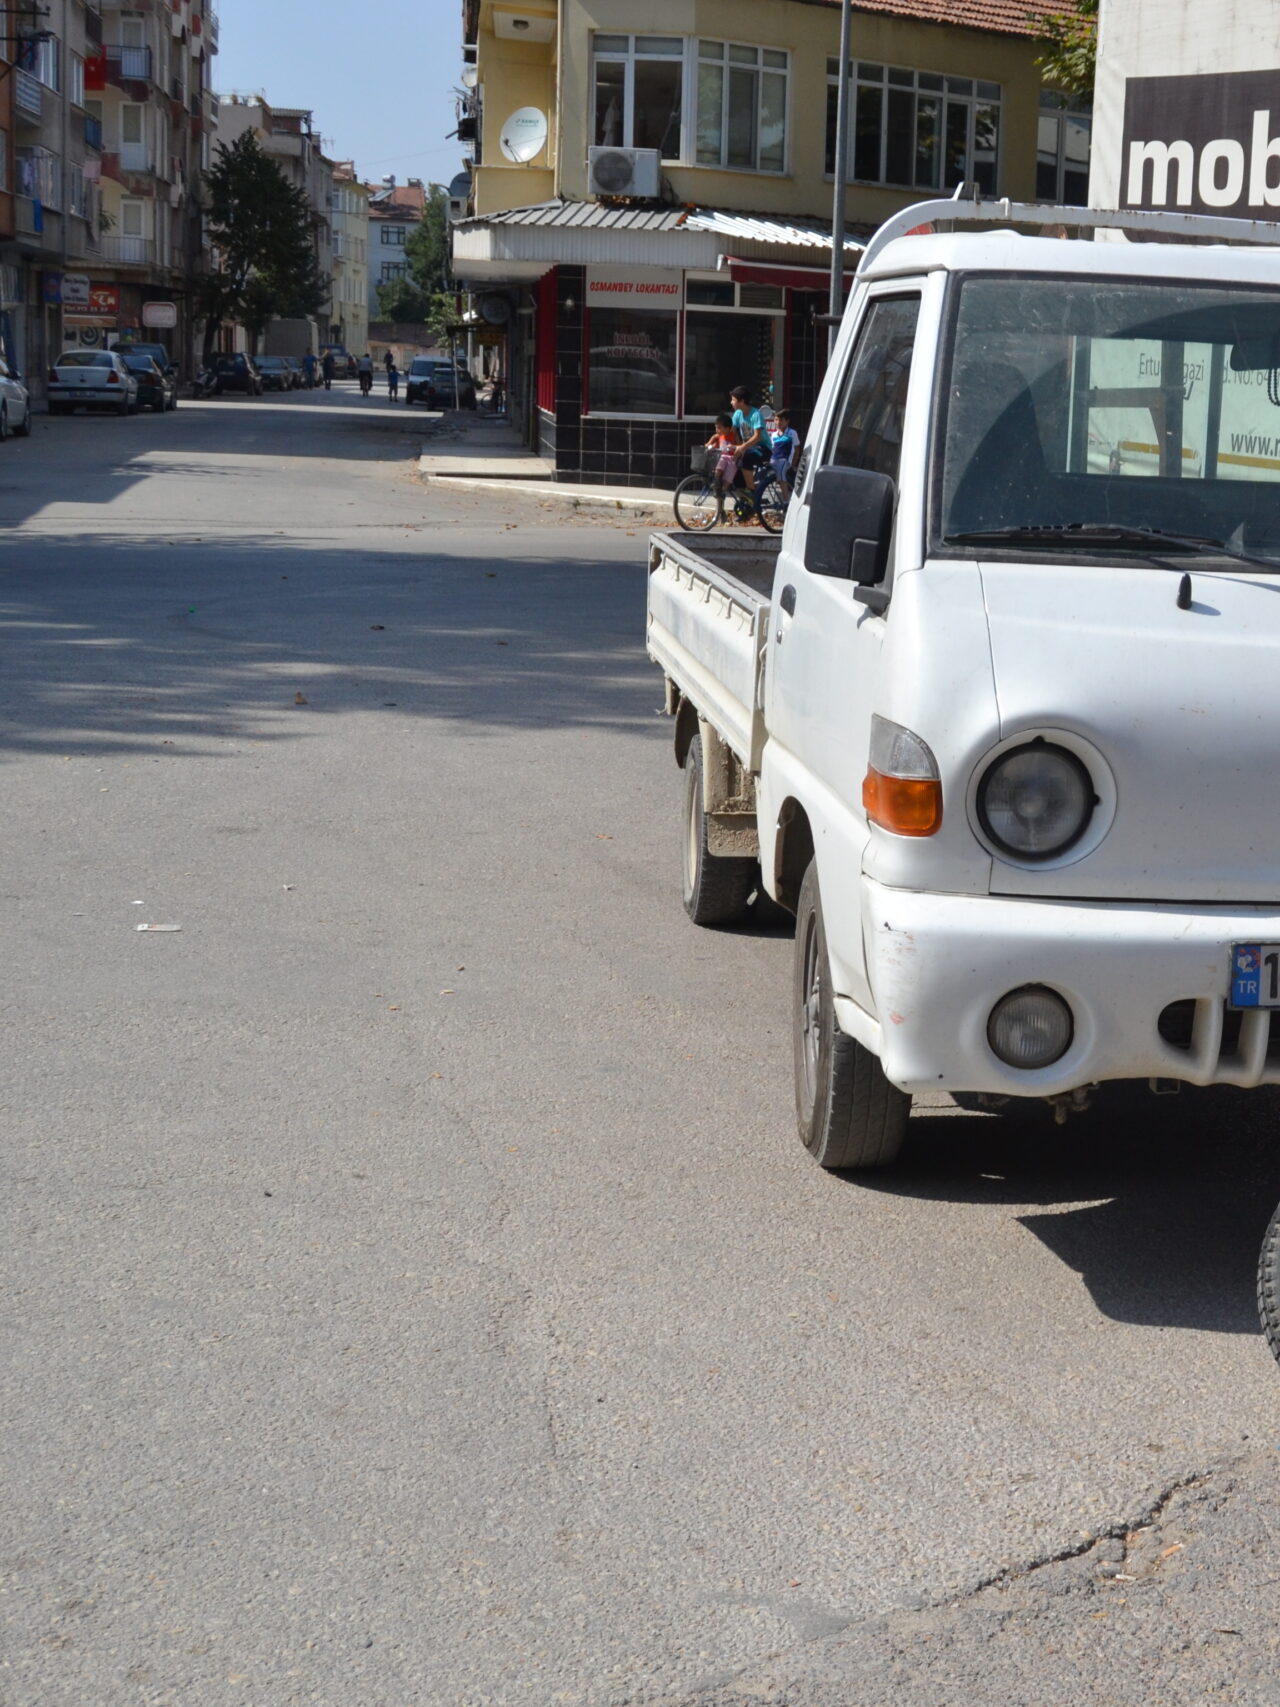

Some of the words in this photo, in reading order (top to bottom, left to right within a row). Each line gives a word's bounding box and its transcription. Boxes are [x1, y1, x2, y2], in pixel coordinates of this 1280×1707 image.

[590, 282, 633, 293] OSMANBEY
[636, 284, 679, 294] LOKANTASI
[1238, 981, 1257, 995] TR
